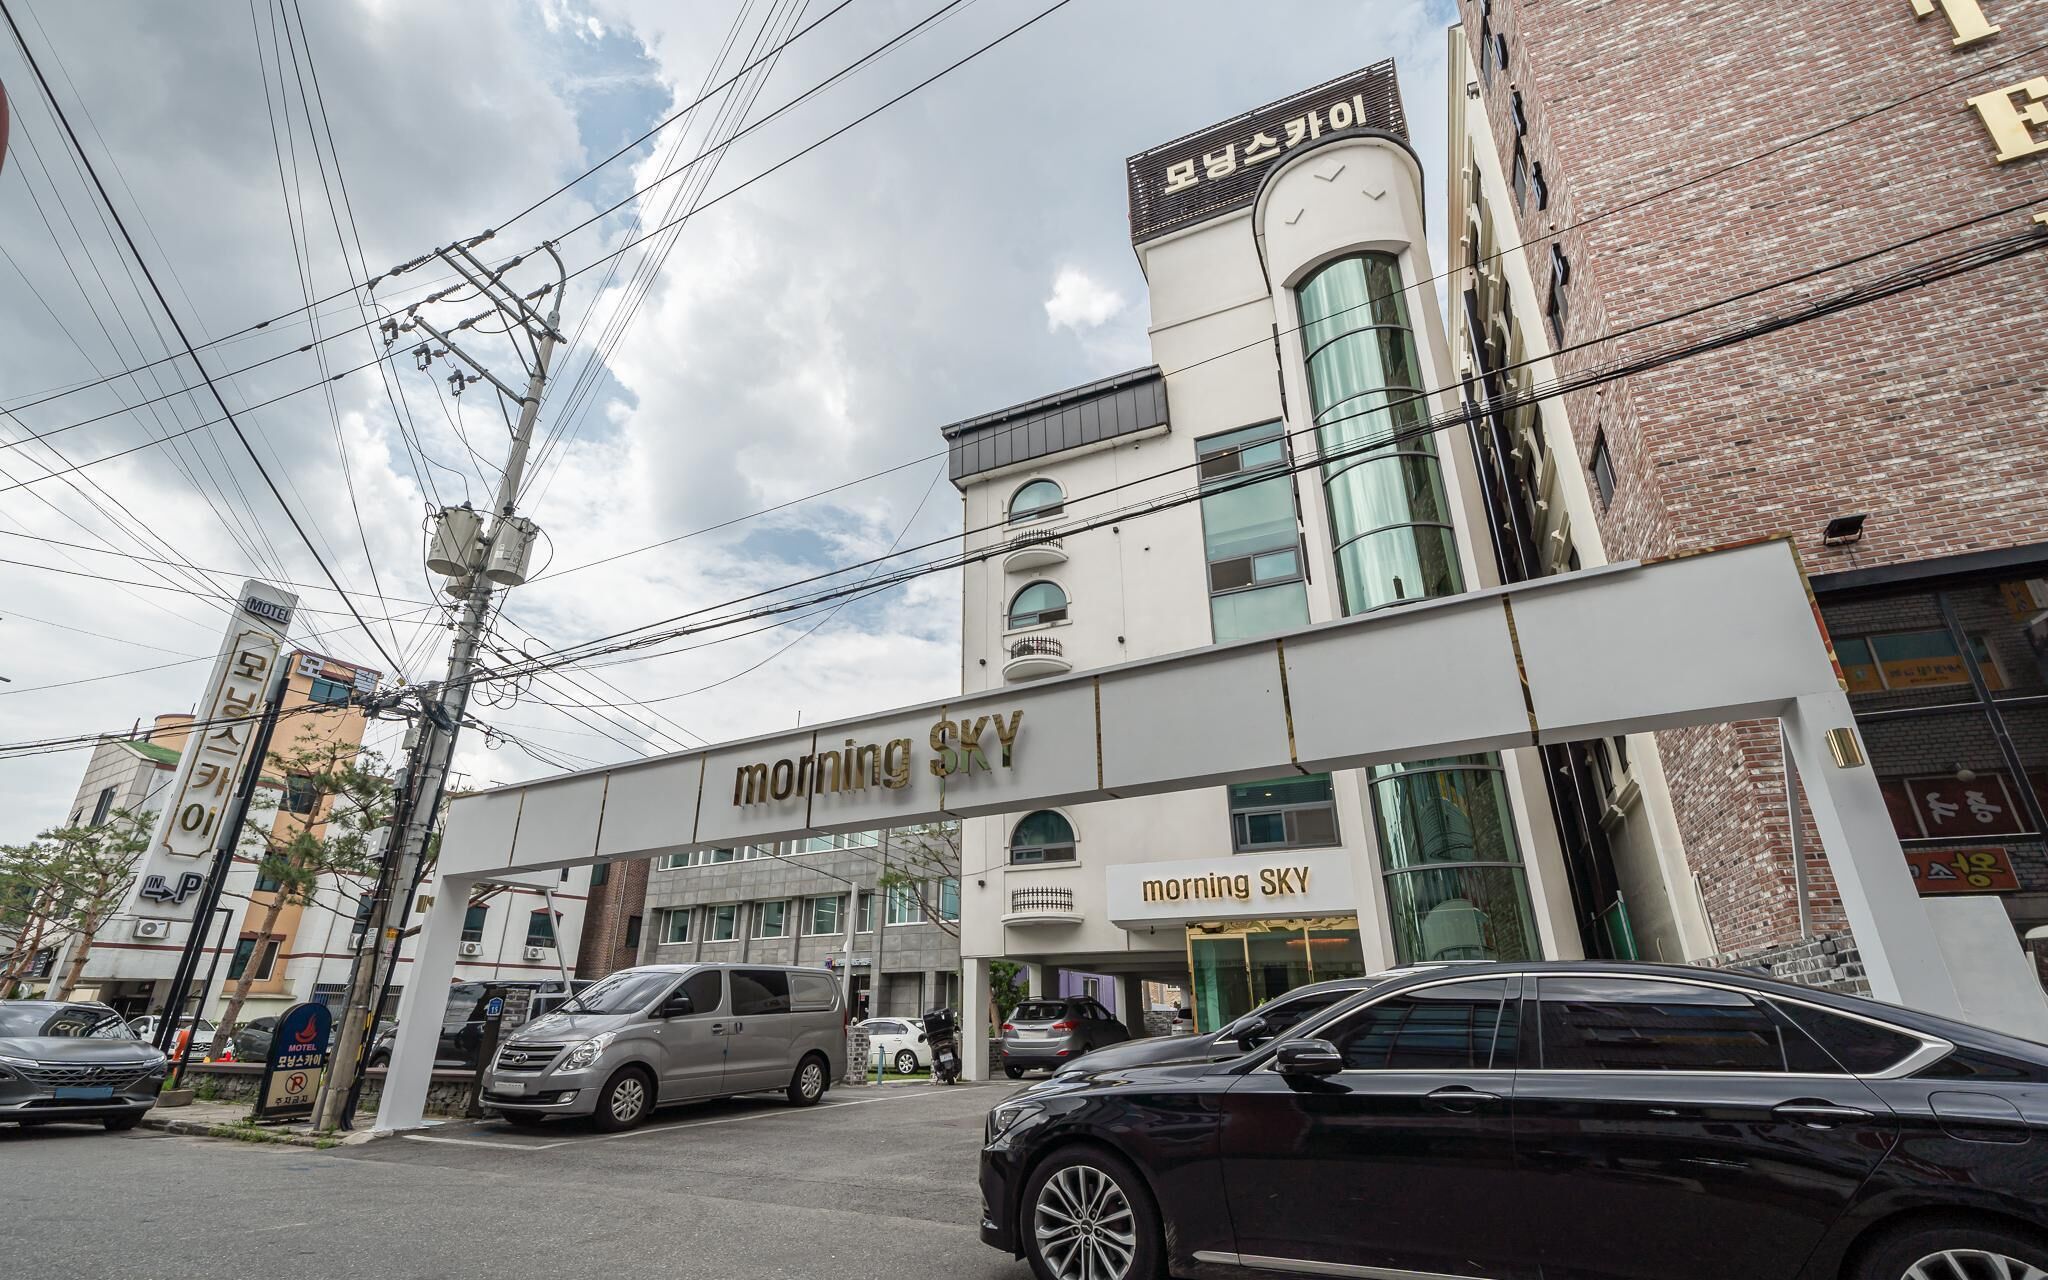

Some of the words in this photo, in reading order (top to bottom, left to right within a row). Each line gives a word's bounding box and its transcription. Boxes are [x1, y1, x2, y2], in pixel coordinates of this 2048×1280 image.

[1164, 94, 1368, 195] 모닝스카이
[249, 598, 290, 622] MOTEL
[180, 651, 268, 836] 모닝스카이
[733, 738, 912, 806] morning
[930, 710, 1024, 777] SKY
[148, 877, 163, 889] IN
[176, 873, 203, 902] P
[1142, 872, 1250, 902] morning
[1260, 866, 1310, 896] SKY
[277, 1054, 322, 1068] 모닝스카이
[288, 1043, 317, 1052] MOTEL
